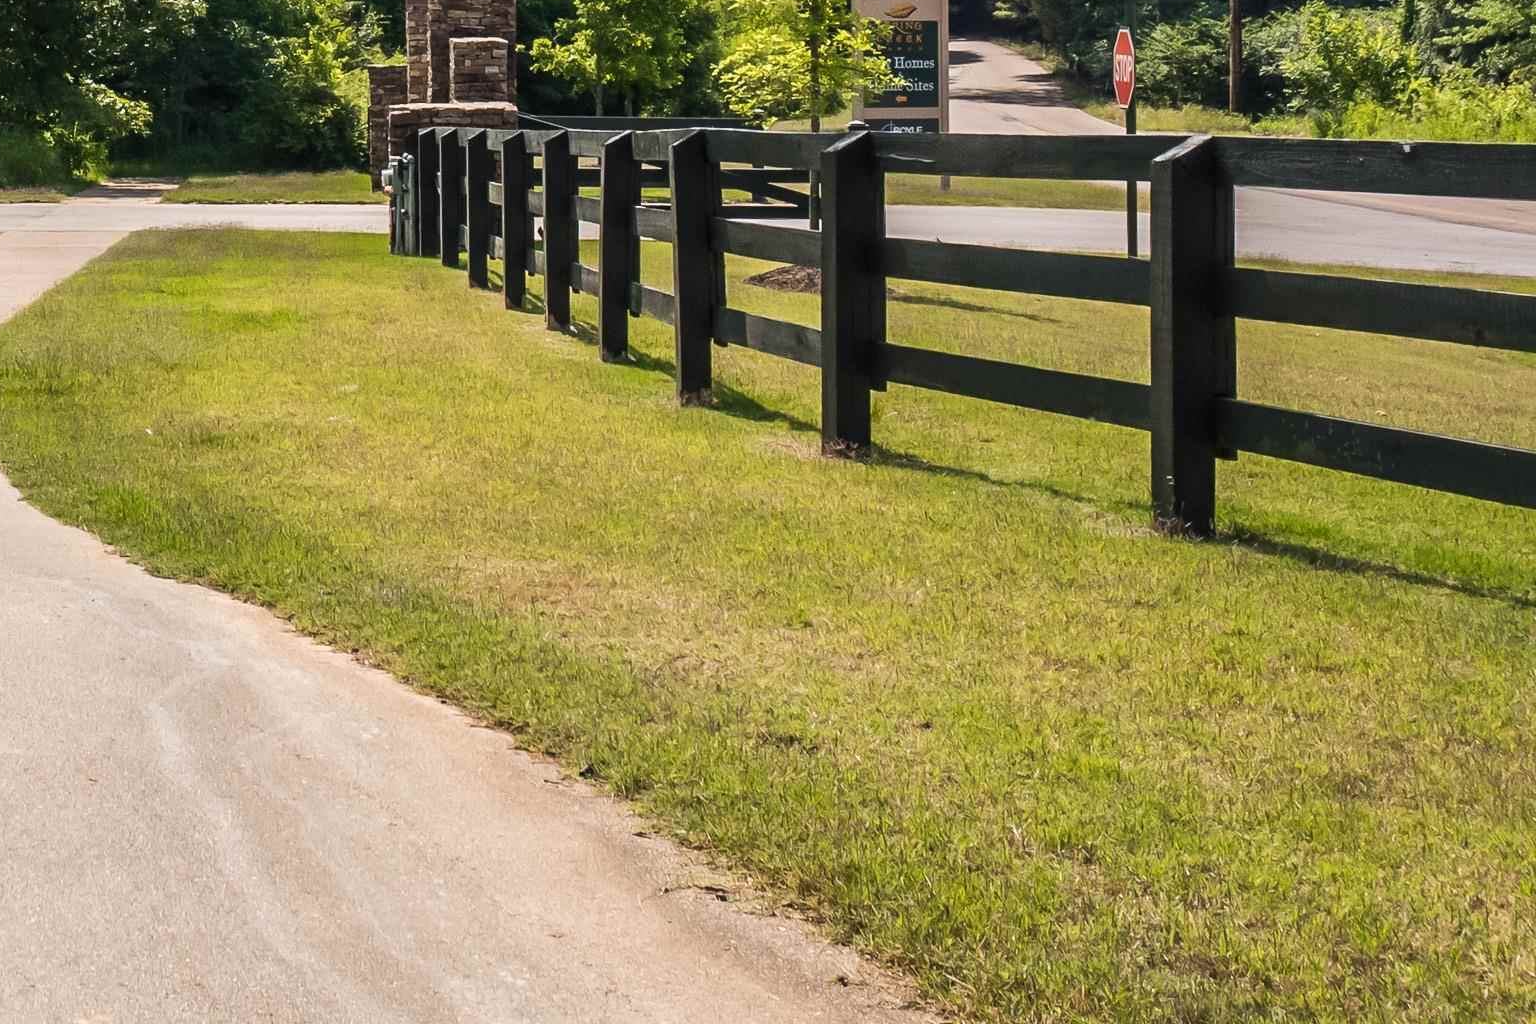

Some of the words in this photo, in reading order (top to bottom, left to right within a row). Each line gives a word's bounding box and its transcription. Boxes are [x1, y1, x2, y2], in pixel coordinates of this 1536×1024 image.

[894, 56, 935, 69] Homes
[1115, 53, 1133, 82] STOP
[904, 77, 935, 91] Sites
